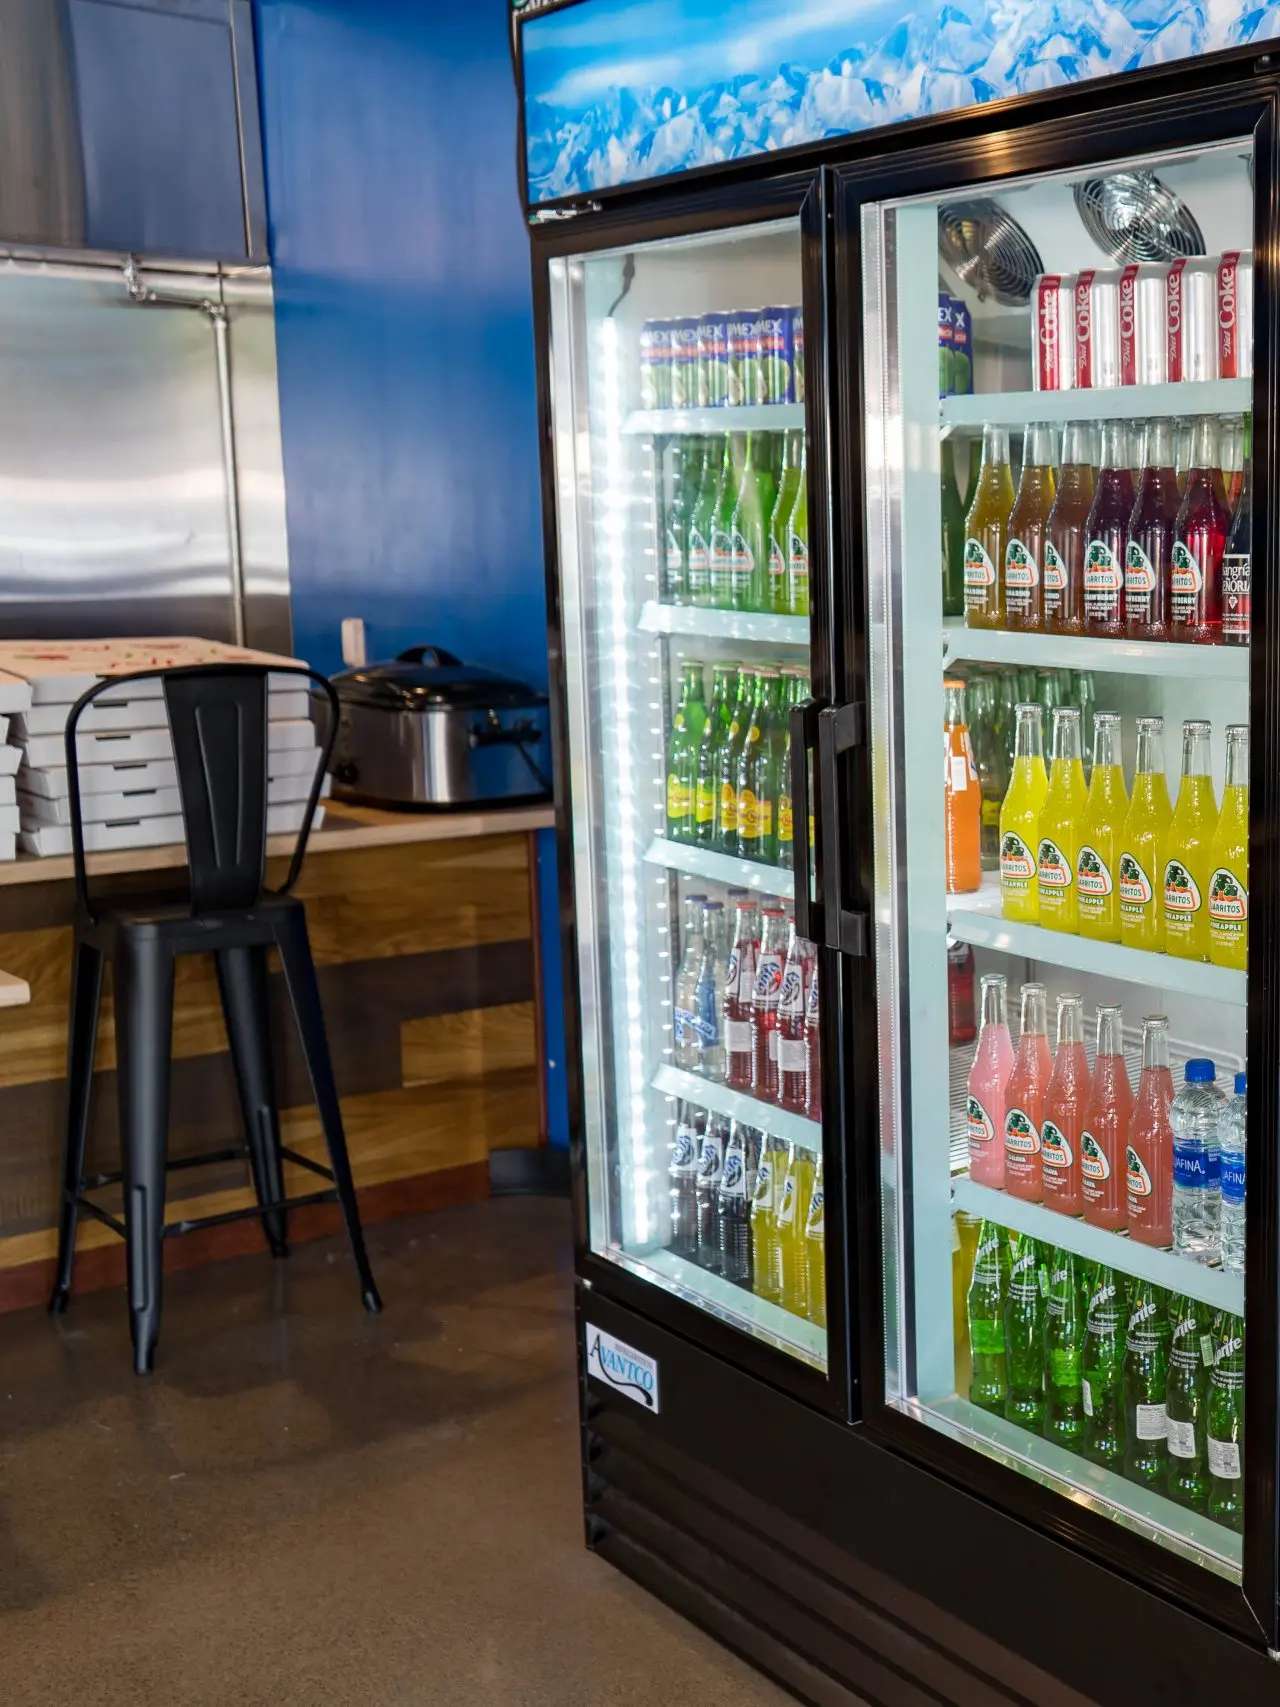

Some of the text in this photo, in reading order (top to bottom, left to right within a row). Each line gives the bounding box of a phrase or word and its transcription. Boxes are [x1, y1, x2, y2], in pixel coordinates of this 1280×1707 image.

[1120, 279, 1134, 338] Coke
[1168, 273, 1180, 334] Coke
[1219, 268, 1236, 329] Coke
[758, 319, 782, 334] MEX
[1040, 288, 1057, 346] Coke
[1076, 284, 1090, 342] Coke
[1086, 575, 1114, 584] ARRITOS
[1003, 863, 1027, 873] ARRITOS
[1038, 870, 1062, 881] ARRITOS
[1078, 878, 1102, 889] ARRITOS
[1120, 887, 1142, 898] ARRITOS
[1176, 1156, 1202, 1174] AFINA
[1011, 1253, 1036, 1277] prite
[1090, 1284, 1116, 1313] prite
[1128, 1300, 1157, 1331] prite
[1172, 1316, 1197, 1344] prite
[588, 1333, 654, 1392] AVANTCO
[1214, 1335, 1242, 1367] prite
